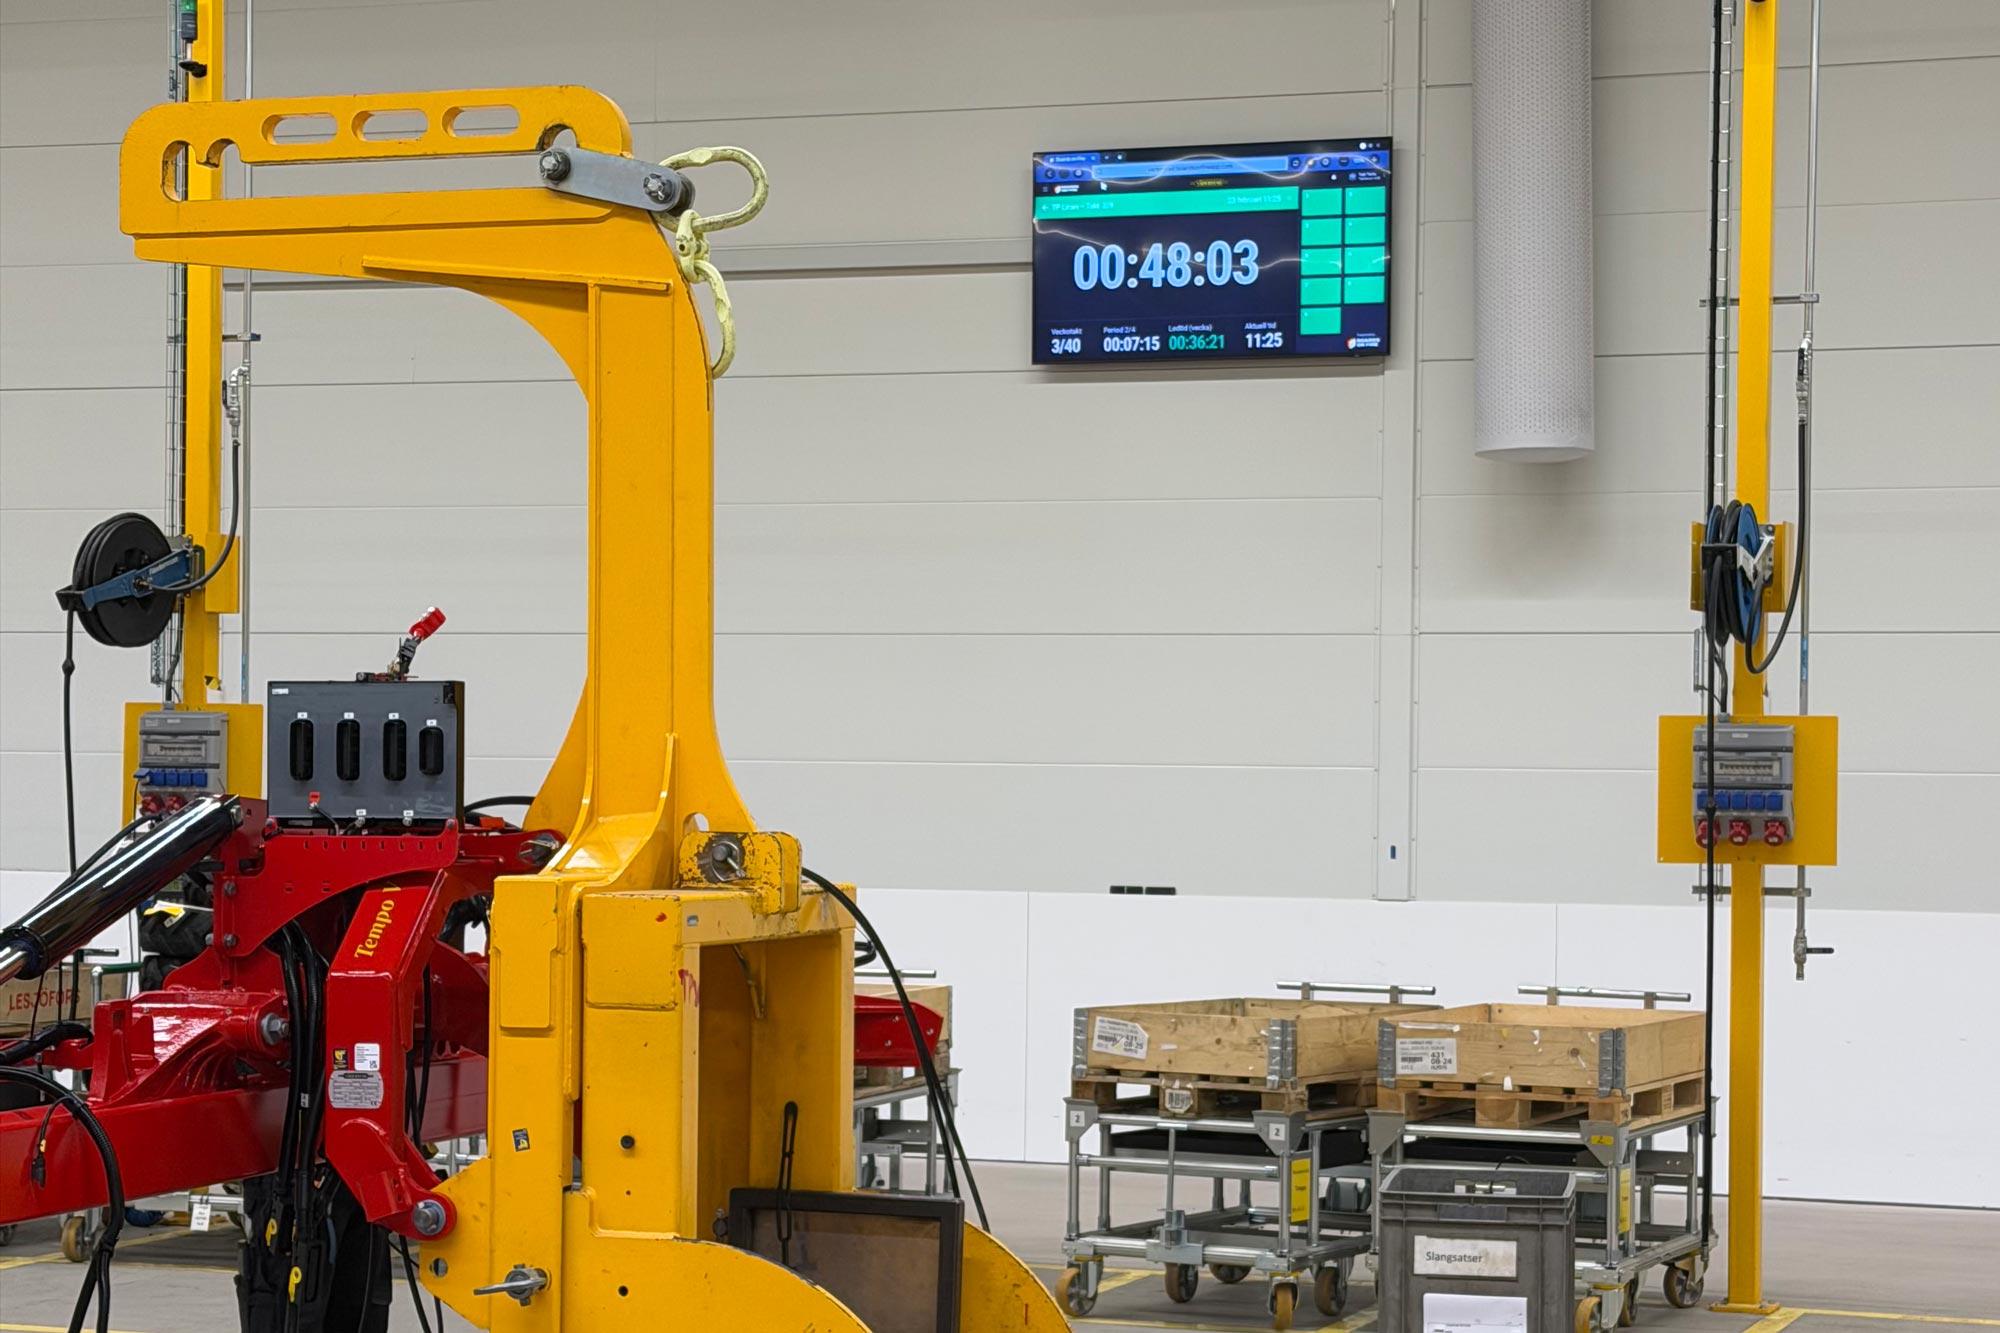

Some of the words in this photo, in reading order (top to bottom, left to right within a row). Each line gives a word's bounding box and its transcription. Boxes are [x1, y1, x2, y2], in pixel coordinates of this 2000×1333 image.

[1073, 239, 1260, 290] 00:48:03
[1103, 327, 1123, 335] Period
[1051, 338, 1082, 355] 3/40
[1103, 336, 1161, 353] 00:07:15
[1168, 334, 1225, 351] 00:36:21
[1245, 332, 1284, 349] 11:25
[354, 899, 395, 958] Tempo
[1273, 1126, 1281, 1138] 2
[1425, 1251, 1483, 1264] Slangsatser
